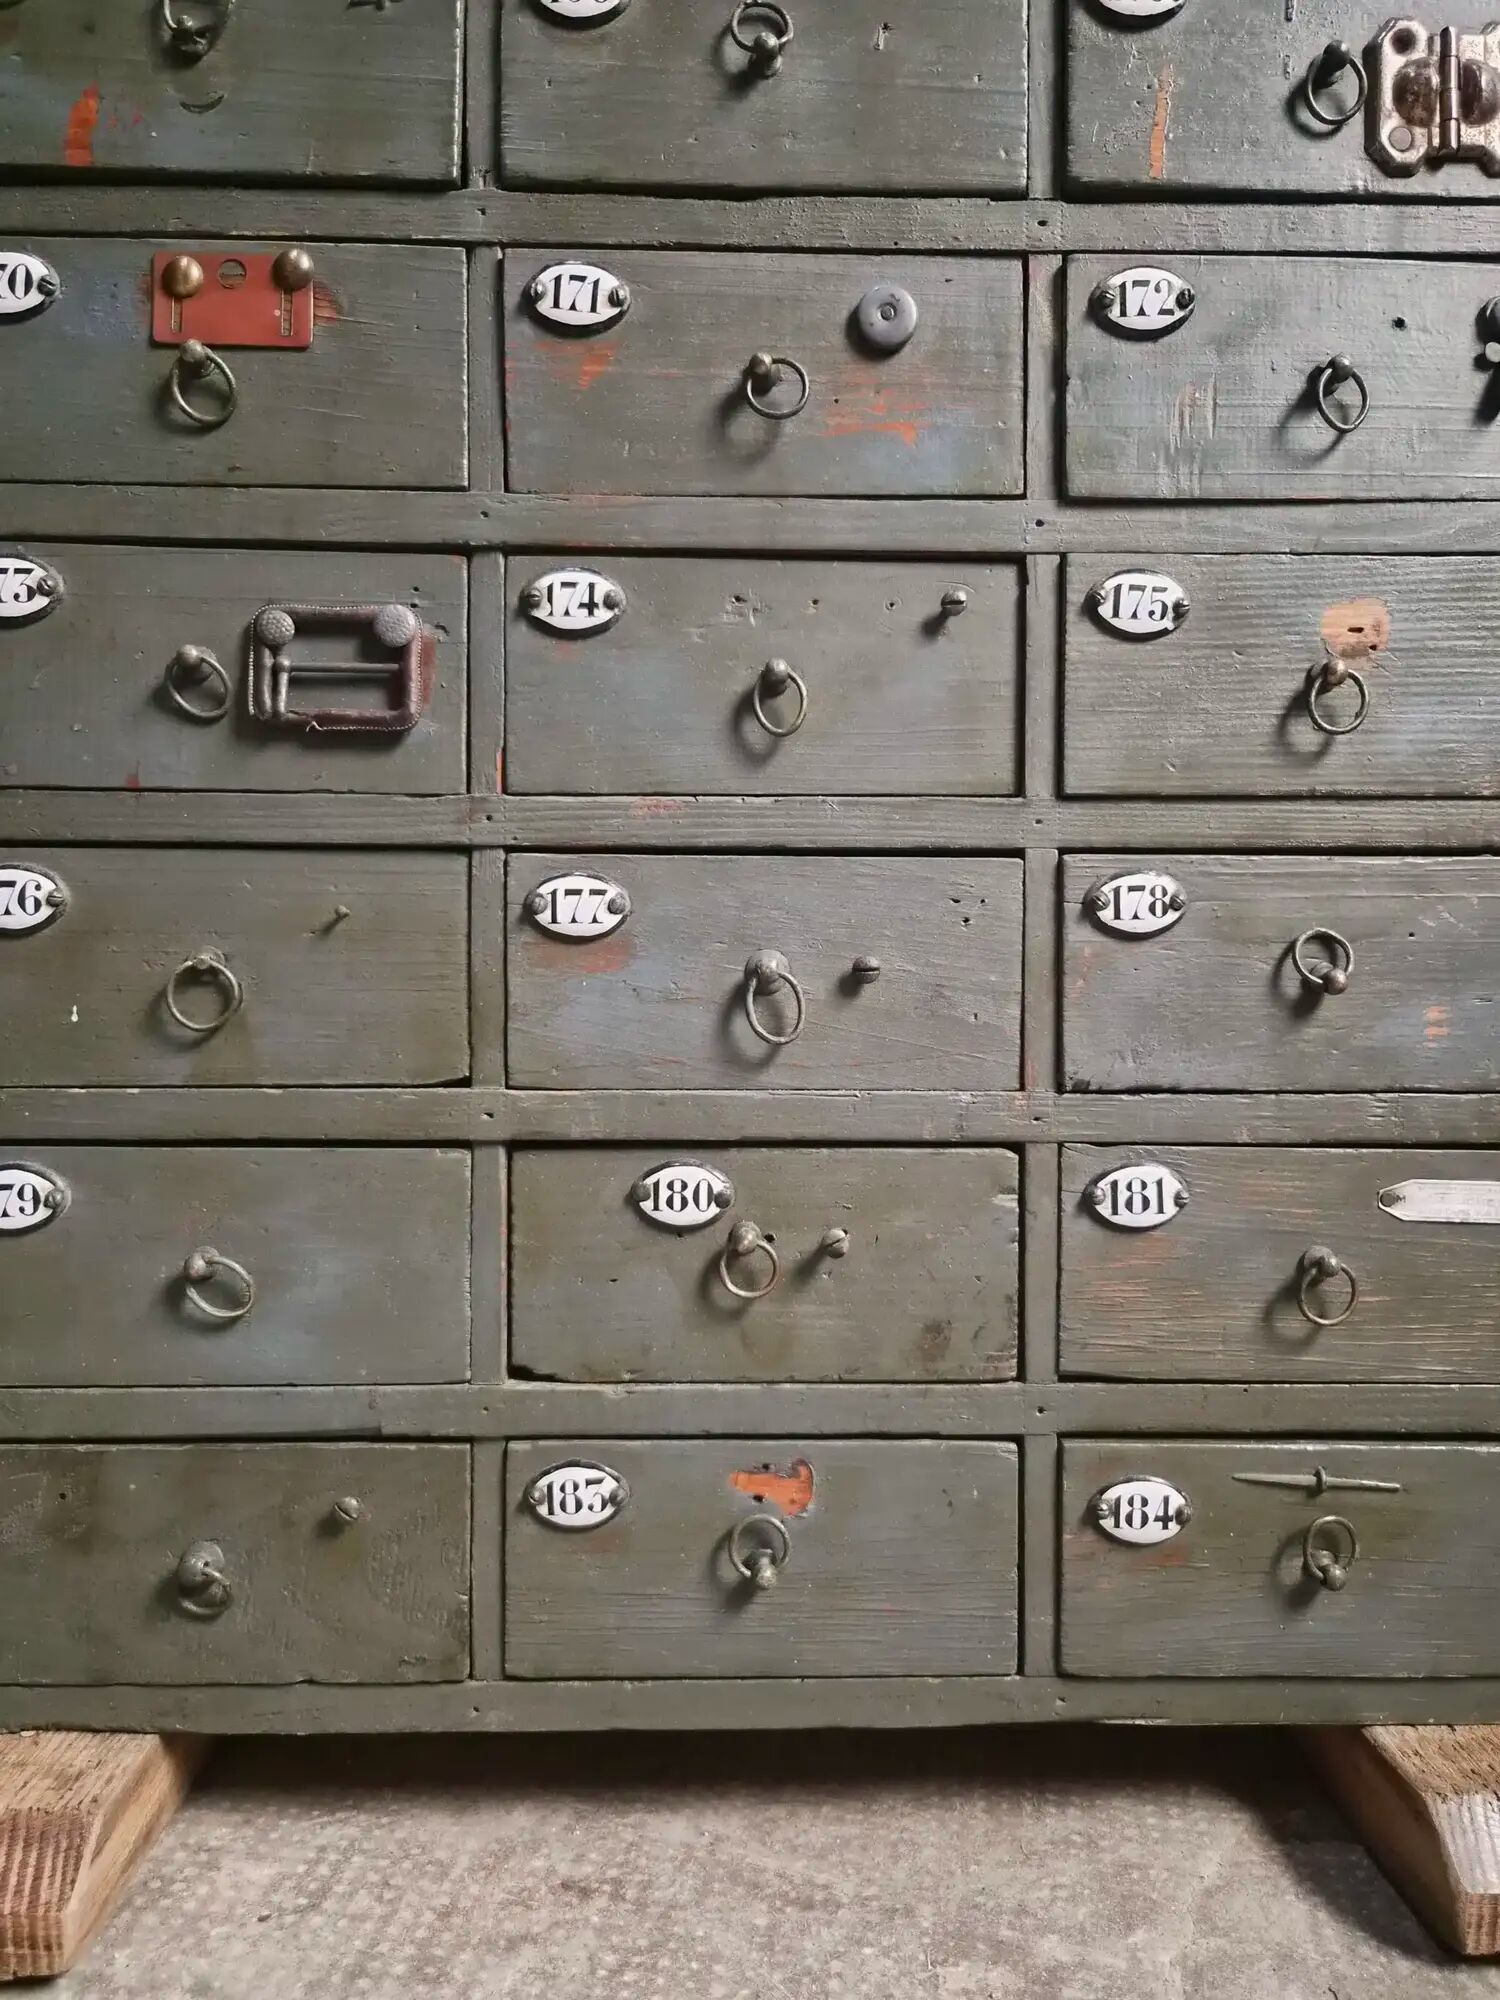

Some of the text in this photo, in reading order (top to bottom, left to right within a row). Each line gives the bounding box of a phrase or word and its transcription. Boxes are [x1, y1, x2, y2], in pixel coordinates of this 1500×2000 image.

[548, 274, 601, 315] 171
[1116, 279, 1175, 318] 172
[546, 582, 599, 617] 174
[1112, 582, 1168, 621] 175
[0, 879, 42, 916] 76
[547, 888, 608, 924] 177
[1111, 884, 1170, 920] 178
[0, 1183, 41, 1217] 79
[650, 1179, 714, 1212] 180
[1108, 1178, 1166, 1215] 181
[546, 1478, 609, 1516] 183
[1112, 1494, 1174, 1530] 184
